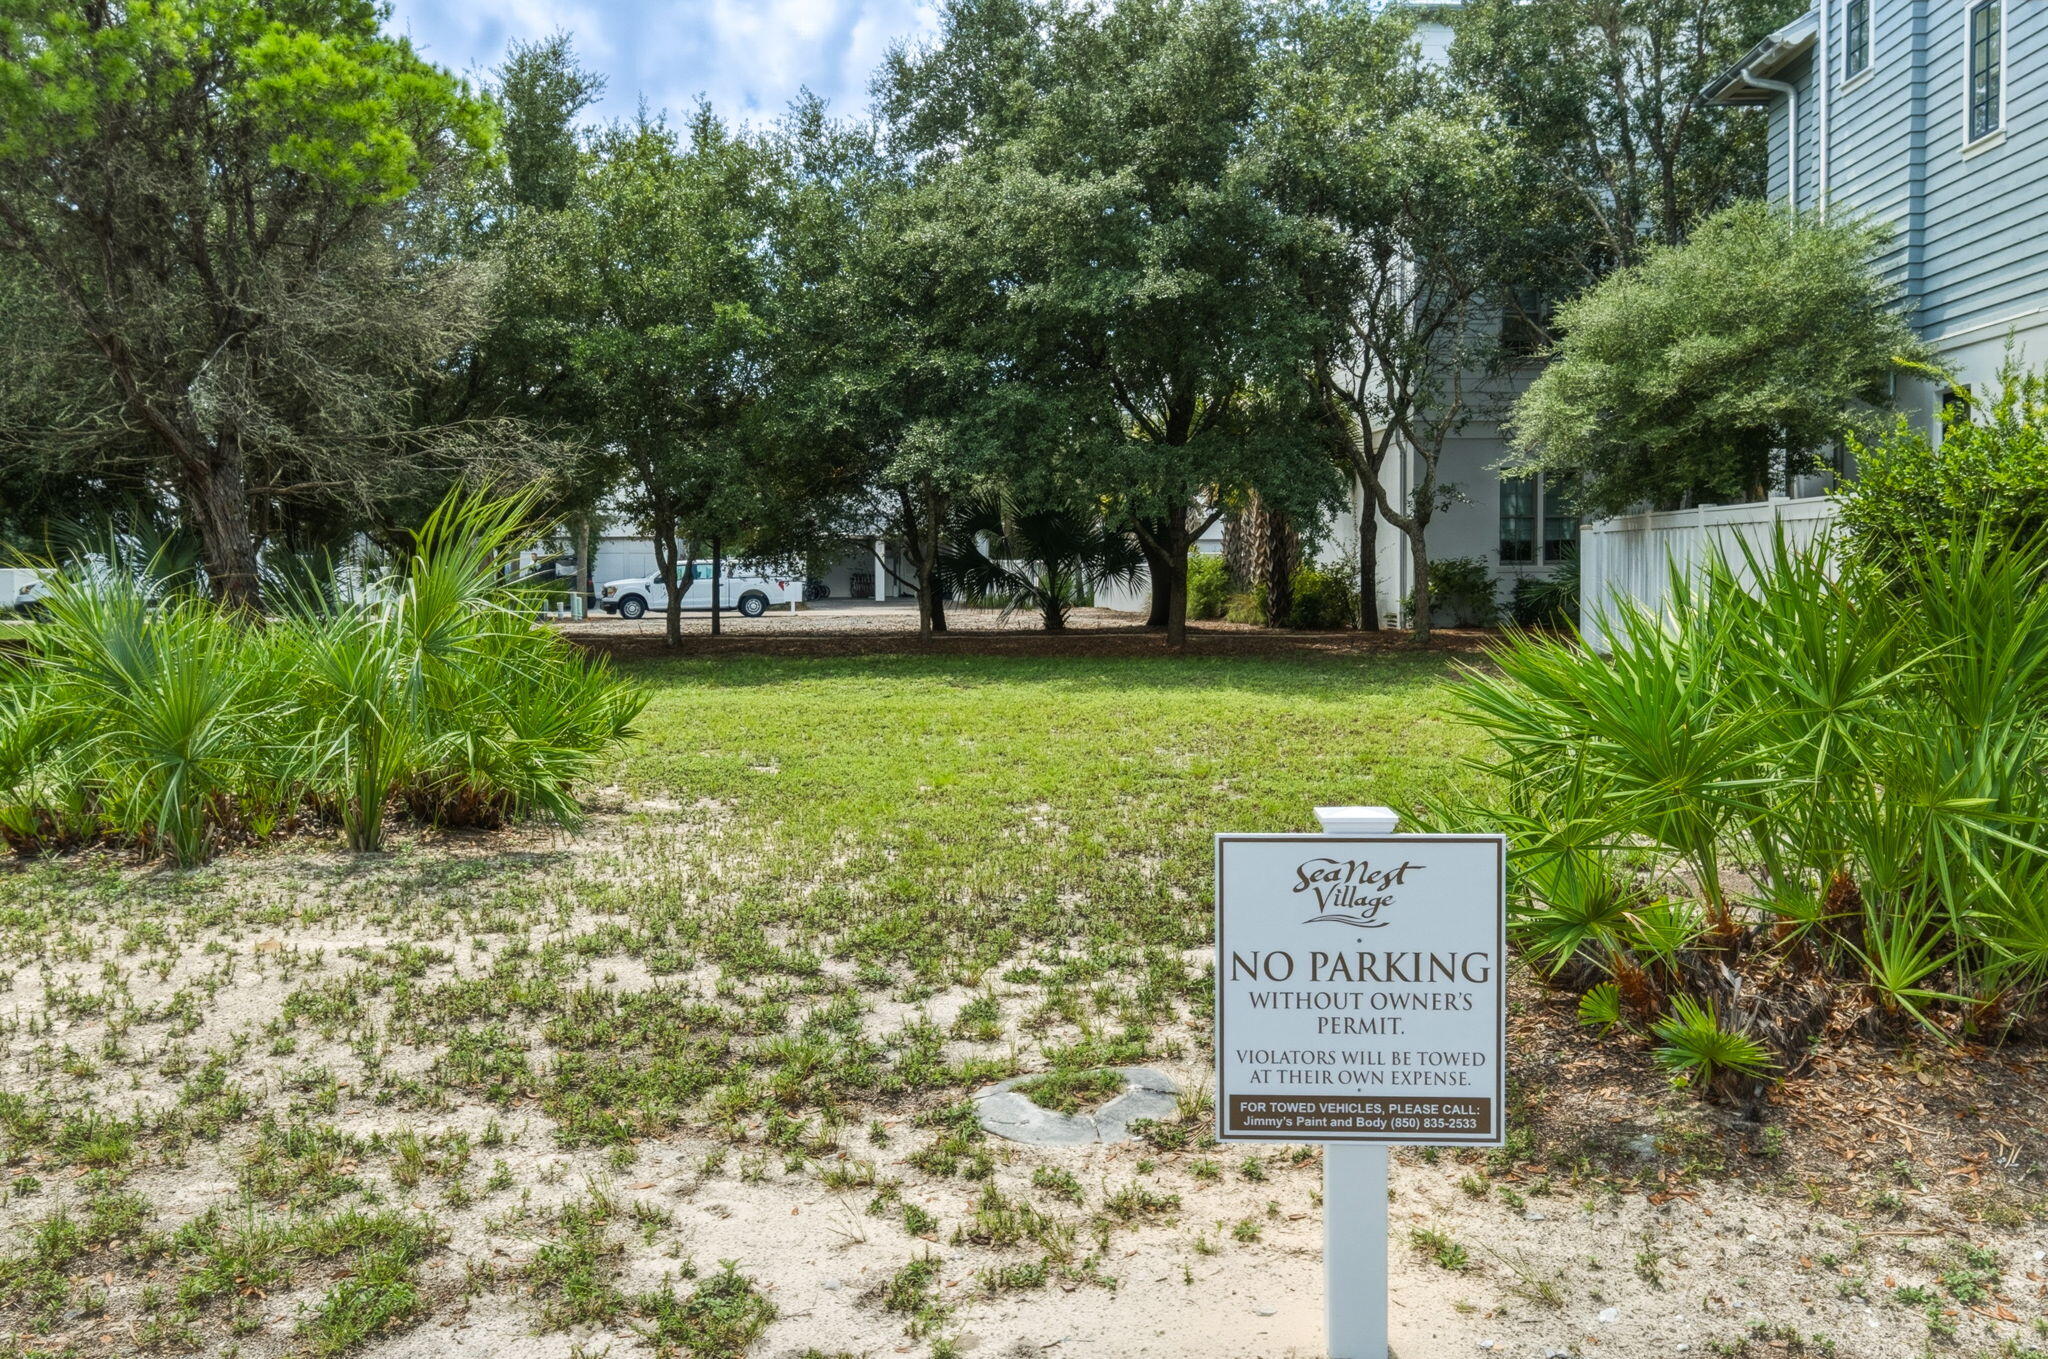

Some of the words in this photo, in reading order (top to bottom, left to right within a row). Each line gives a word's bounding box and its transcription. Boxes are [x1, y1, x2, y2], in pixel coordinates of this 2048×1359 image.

[1313, 886, 1397, 918] Village
[1230, 950, 1294, 982] NO
[1309, 952, 1491, 983] PARKING
[1249, 992, 1363, 1010] WITHOUT
[1370, 993, 1473, 1011] OWNER'S
[1318, 1017, 1405, 1035] PERMIT.
[1236, 1050, 1336, 1065] VIOLATORS
[1342, 1051, 1385, 1065] WILL
[1392, 1051, 1411, 1066] BE
[1418, 1052, 1486, 1066] TOWED
[1250, 1070, 1272, 1084] AT
[1276, 1070, 1333, 1085] THEIR
[1338, 1071, 1384, 1085] OWN
[1392, 1071, 1471, 1086] EXPENSE.
[1240, 1102, 1266, 1113] FOR
[1270, 1103, 1316, 1113] TOWED
[1319, 1103, 1385, 1115] VEHICLES,
[1389, 1104, 1439, 1114] PLEASE
[1443, 1104, 1480, 1115] CALL:
[1244, 1117, 1292, 1128] Jimmy's
[1296, 1117, 1327, 1127] Paint
[1330, 1117, 1352, 1127] and
[1356, 1118, 1386, 1130] Body
[1391, 1118, 1420, 1130] (850)
[1423, 1119, 1477, 1128] 835-2533
